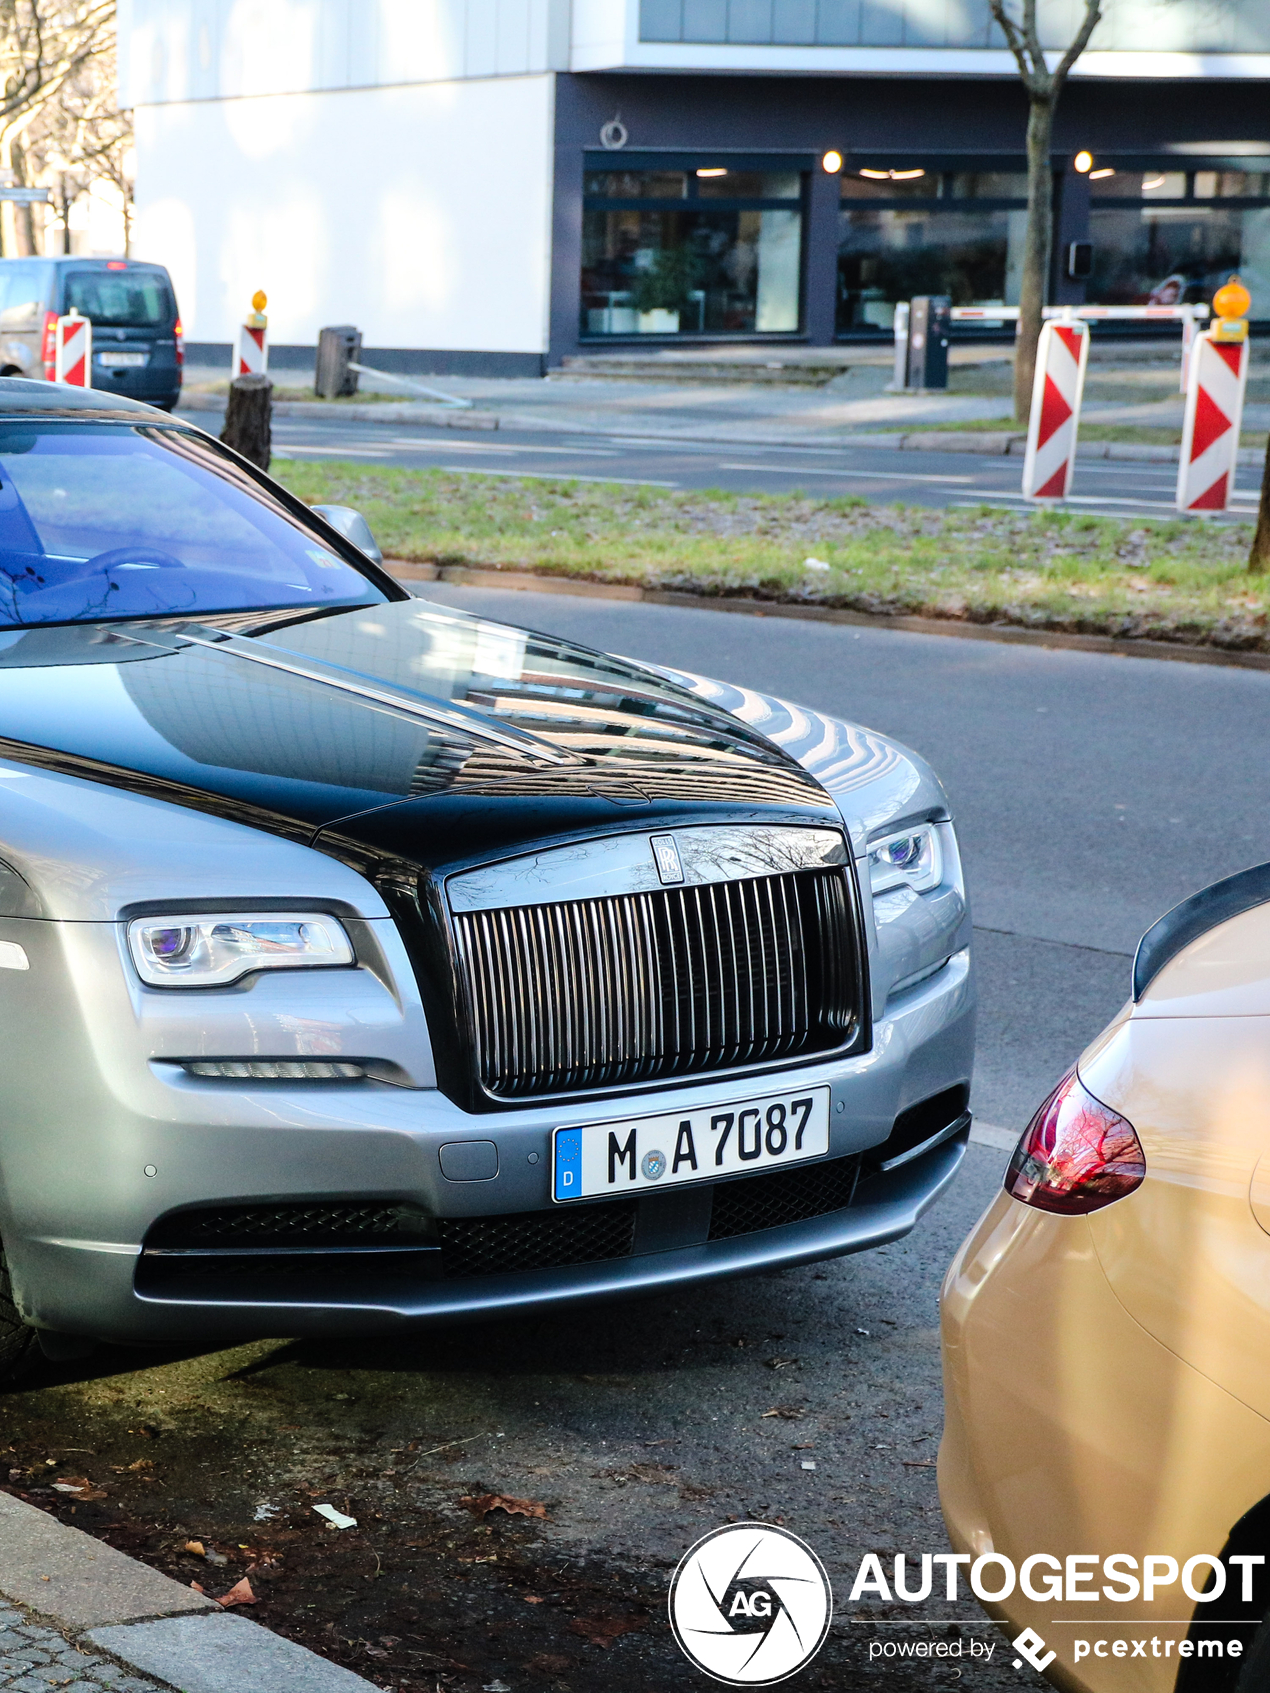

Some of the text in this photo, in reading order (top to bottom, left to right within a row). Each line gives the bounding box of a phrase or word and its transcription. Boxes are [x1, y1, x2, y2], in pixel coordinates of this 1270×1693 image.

[654, 838, 673, 846] ROLLS
[607, 1128, 637, 1184] M
[671, 1119, 698, 1174] A
[710, 1097, 814, 1166] 7087
[562, 1171, 574, 1187] D
